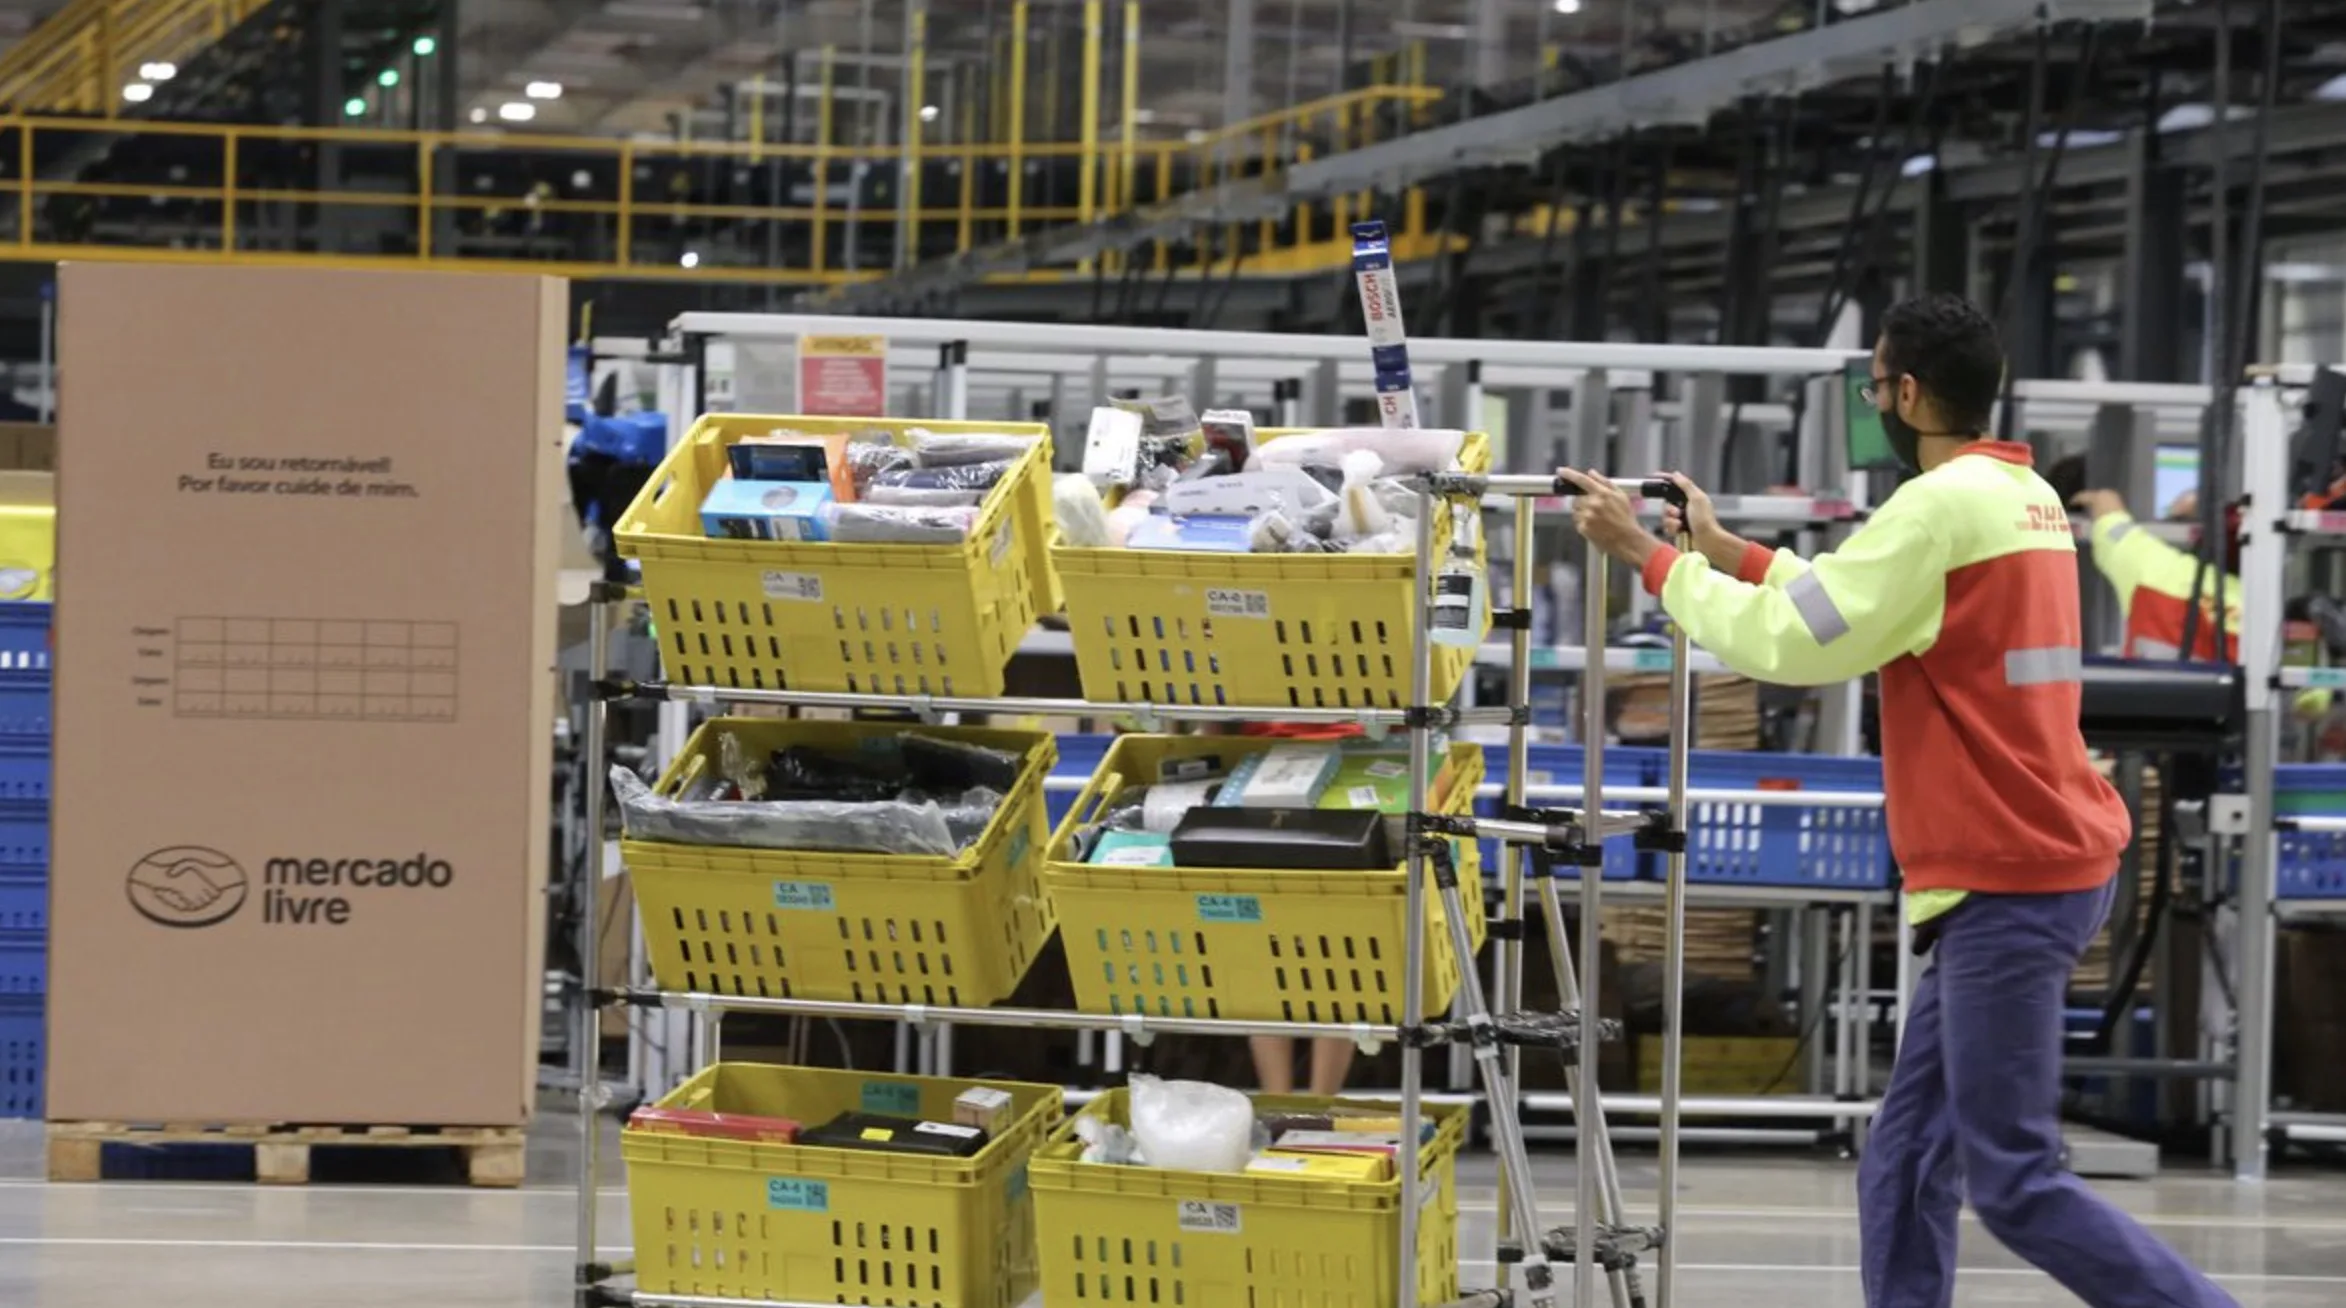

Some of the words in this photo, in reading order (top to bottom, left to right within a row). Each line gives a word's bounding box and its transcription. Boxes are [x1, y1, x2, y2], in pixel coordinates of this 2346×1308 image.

[1364, 272, 1384, 321] BOSCH
[207, 452, 234, 470] Eu
[238, 457, 276, 471] sou
[177, 474, 213, 492] Por
[217, 475, 271, 494] favor
[274, 477, 332, 495] cuide
[335, 479, 363, 497] de
[263, 852, 454, 888] mercado
[262, 889, 352, 925] livre
